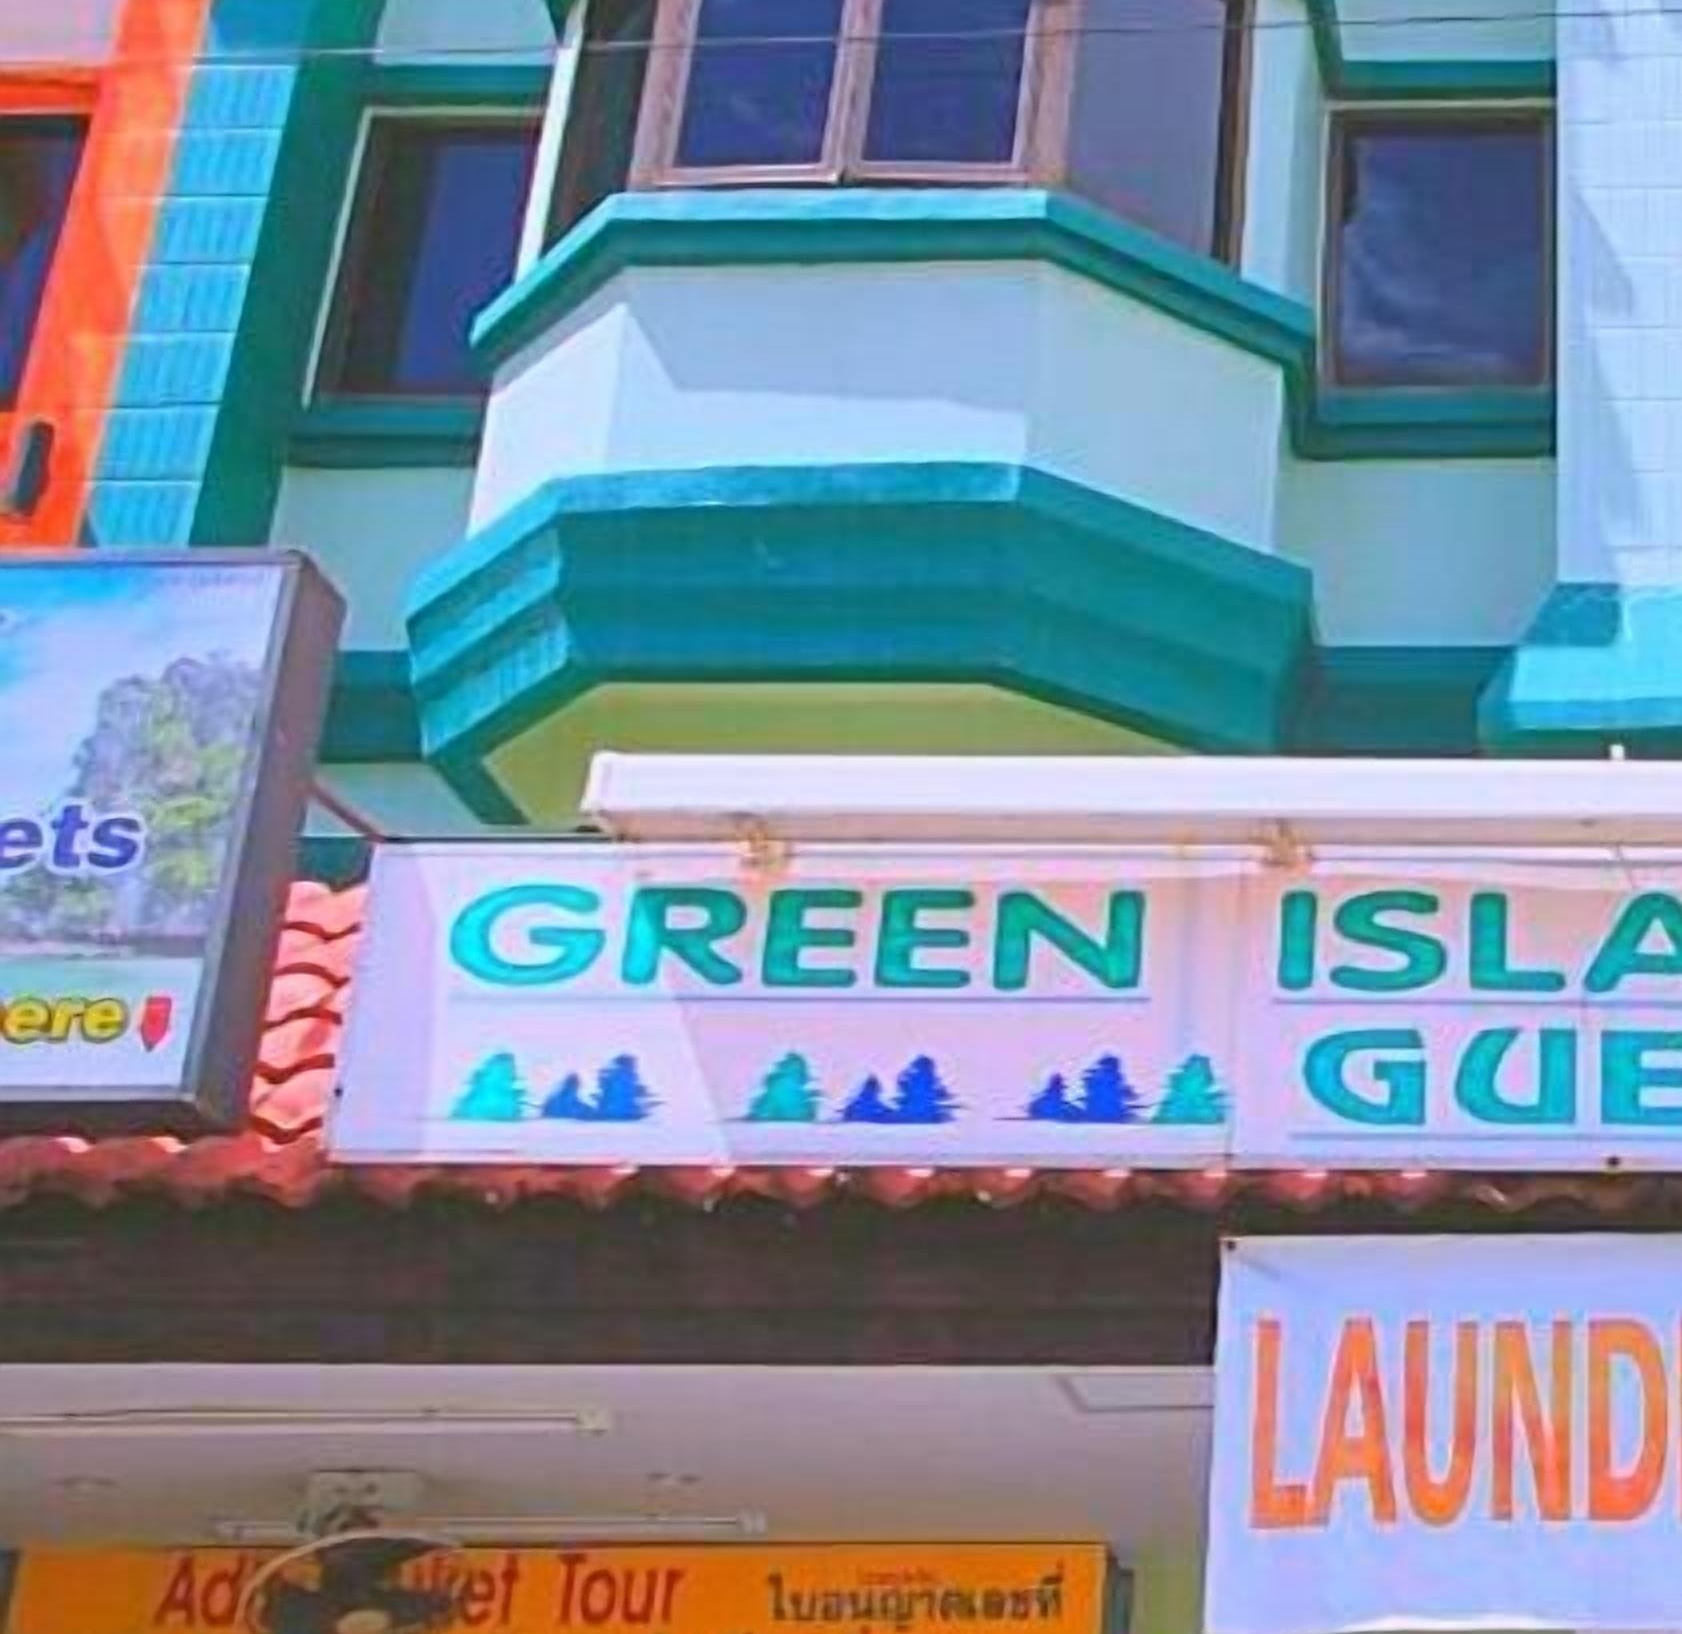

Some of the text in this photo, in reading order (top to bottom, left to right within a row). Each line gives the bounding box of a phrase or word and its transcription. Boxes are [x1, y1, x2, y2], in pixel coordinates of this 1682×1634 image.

[448, 883, 1147, 991] GREEN
[0, 995, 128, 1046] ere
[556, 1552, 684, 1627] Tour
